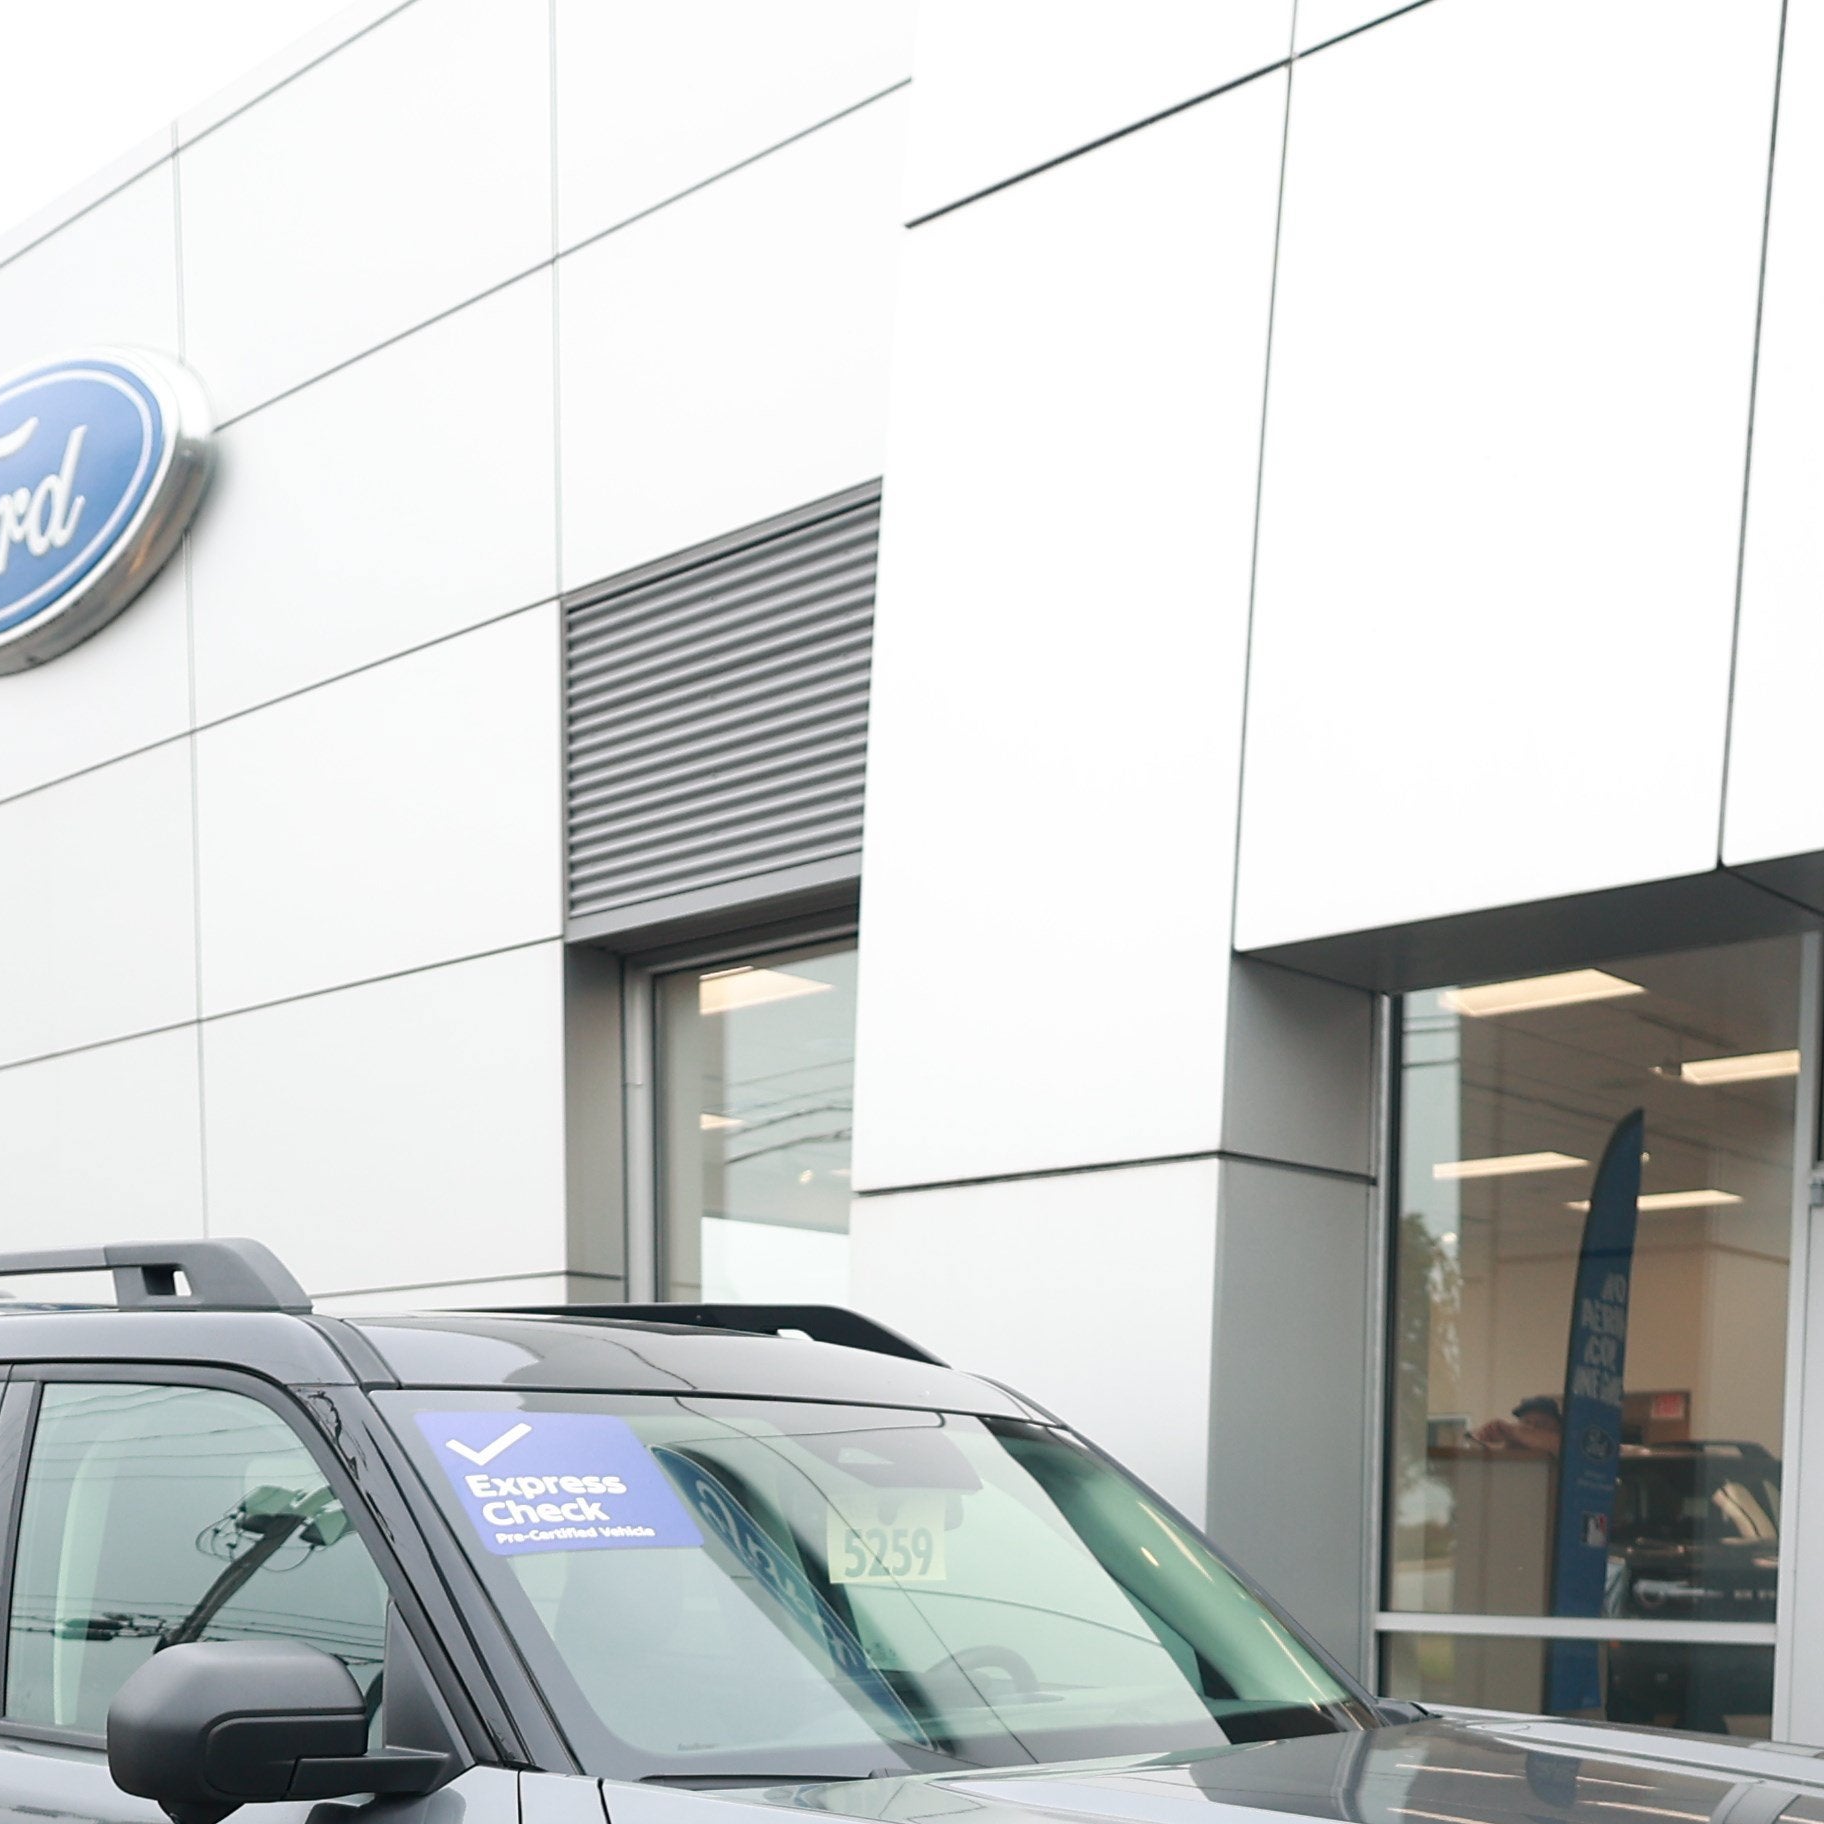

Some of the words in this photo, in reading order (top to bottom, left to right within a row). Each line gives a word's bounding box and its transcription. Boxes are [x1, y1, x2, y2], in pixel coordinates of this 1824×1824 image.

[464, 1474, 627, 1500] Express
[482, 1497, 610, 1526] Check
[495, 1526, 599, 1545] Pre-Certified
[599, 1526, 656, 1537] Vehicle
[843, 1526, 934, 1579] 5259
